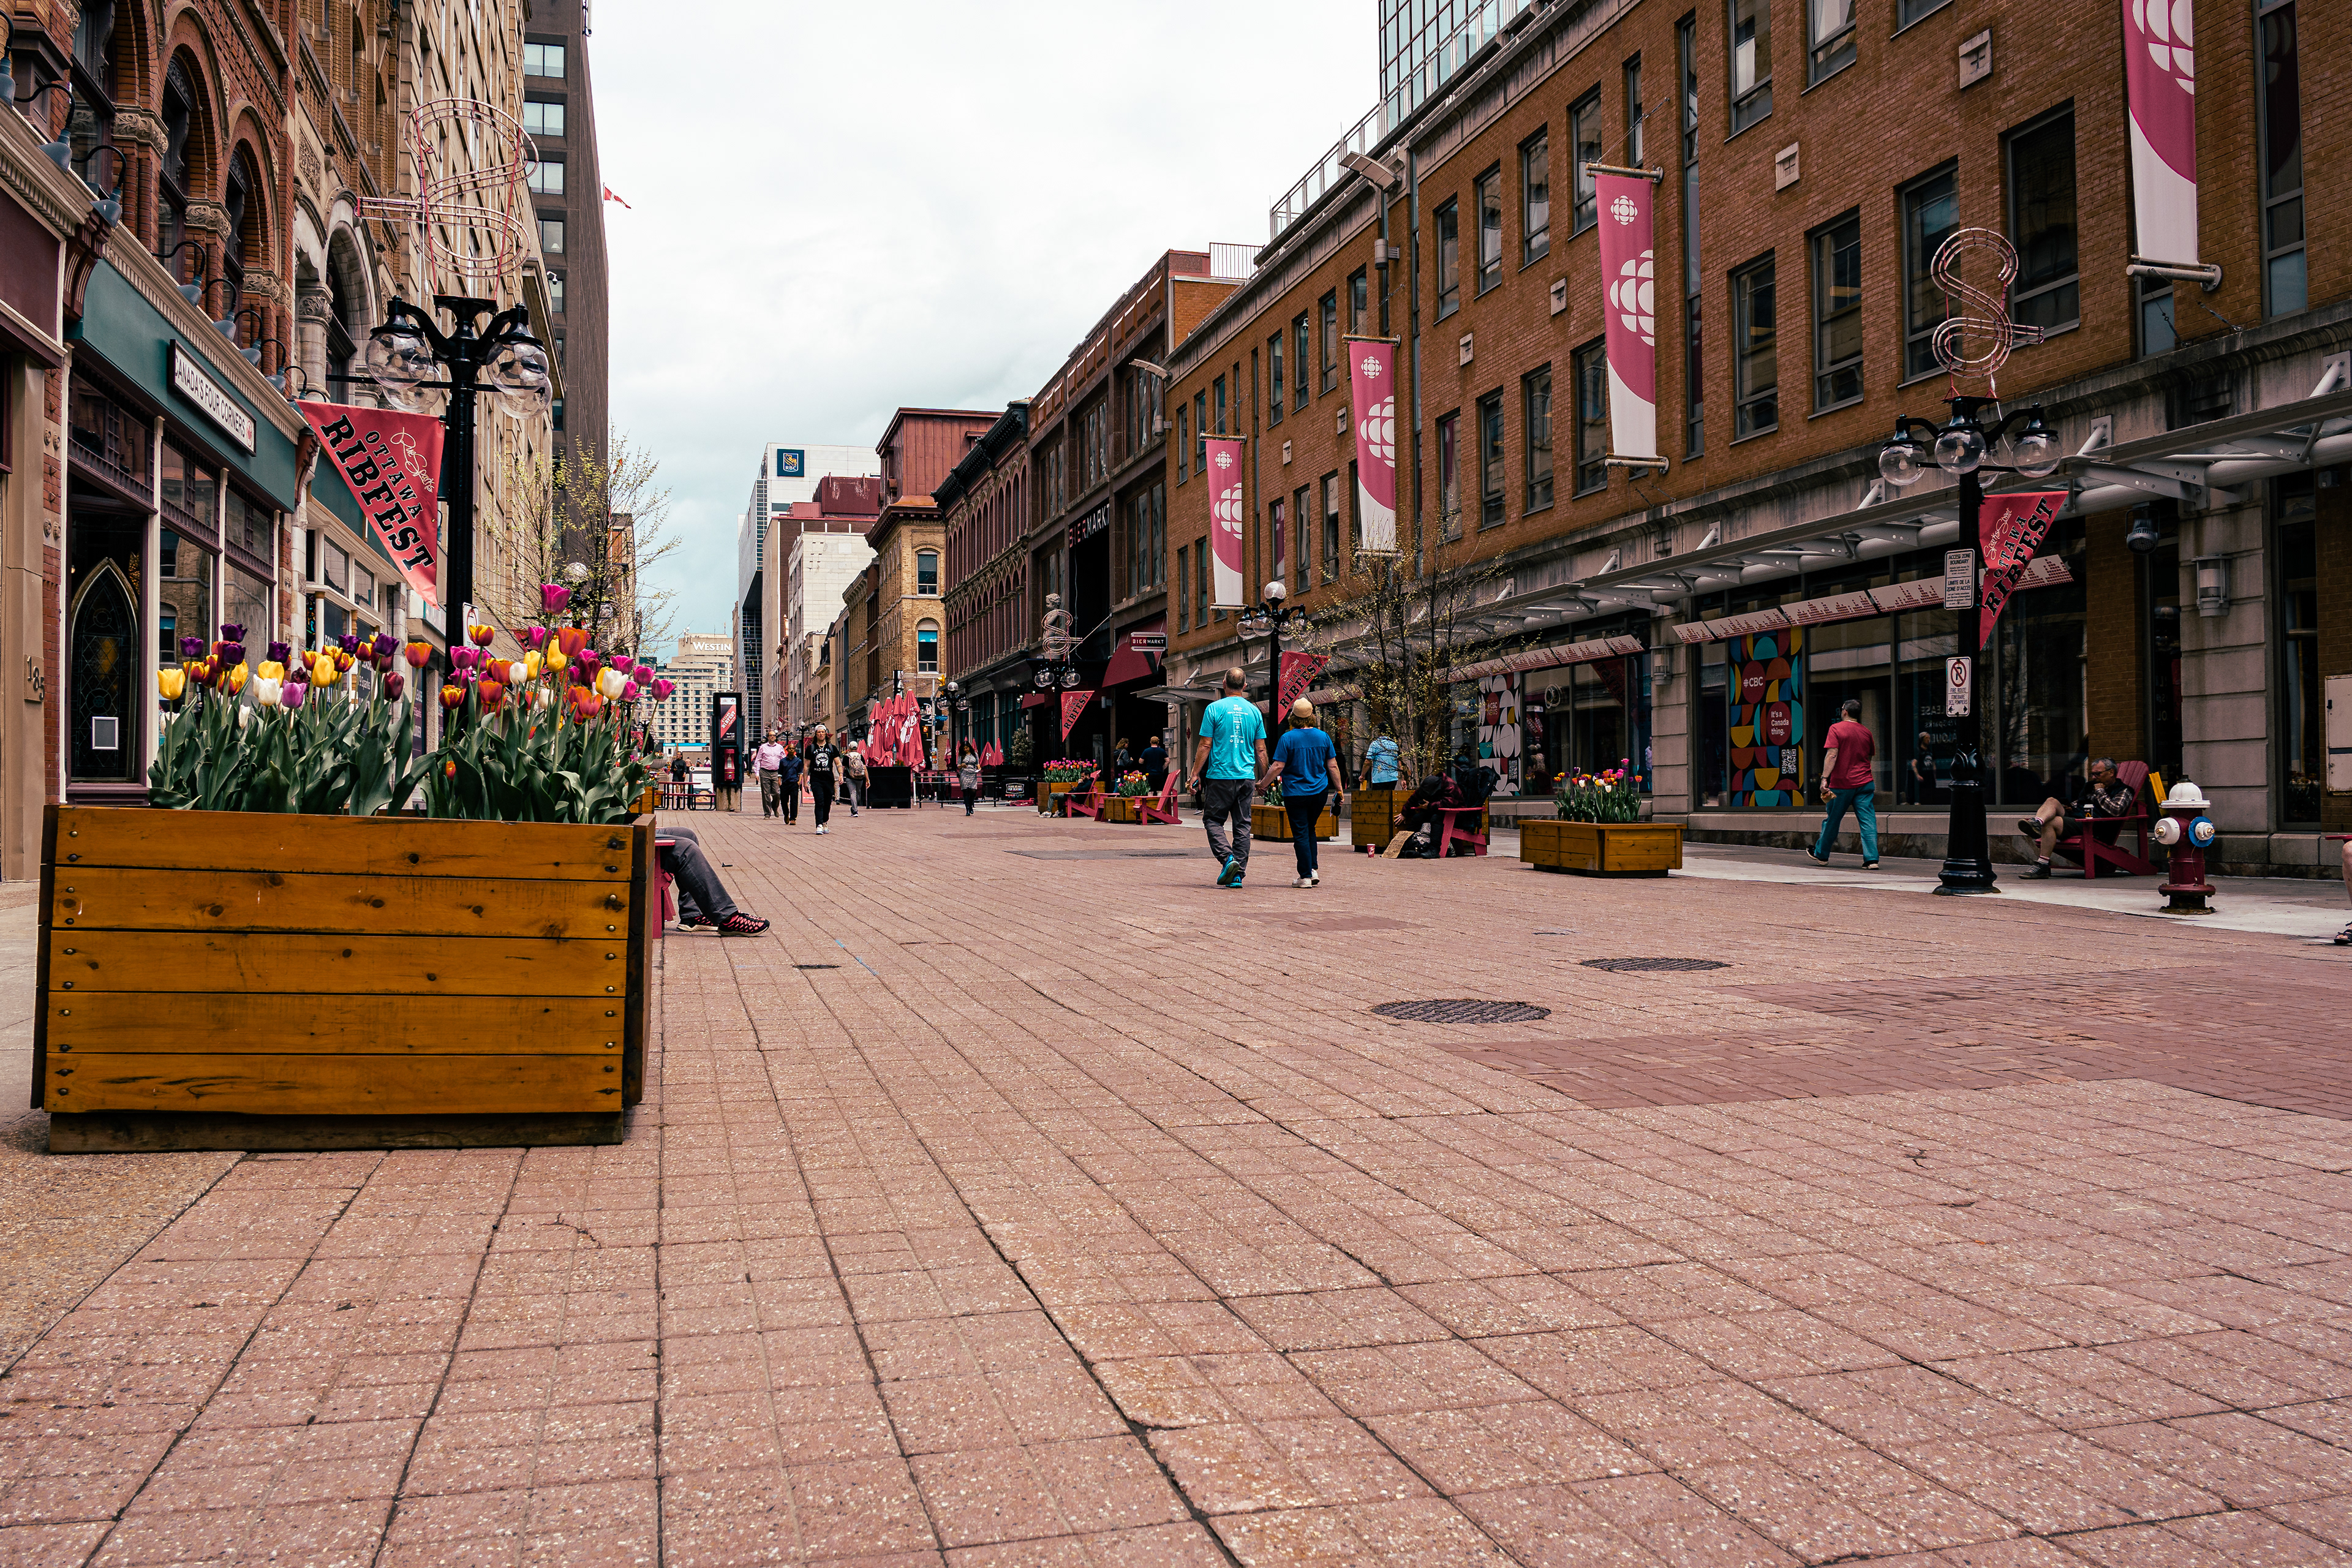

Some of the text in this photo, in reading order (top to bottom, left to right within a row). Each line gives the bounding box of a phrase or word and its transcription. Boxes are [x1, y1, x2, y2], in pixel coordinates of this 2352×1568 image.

[205, 383, 221, 417] FOUR
[221, 399, 246, 439] CORNERS
[318, 413, 436, 572] RIBFEST
[364, 430, 424, 519] OTTAWA
[1069, 503, 1110, 548] BIERMARKT
[1993, 515, 2027, 579] OTTAWA
[1984, 496, 2054, 617] RIBFEST
[693, 641, 731, 651] WESTIN
[27, 656, 45, 701] 185
[1278, 658, 1322, 710] RIBFEST
[1282, 663, 1306, 692] OTTAWA
[1749, 676, 1763, 687] CBC
[1063, 693, 1090, 730] RIBFEST
[1065, 698, 1079, 718] OTTAWA
